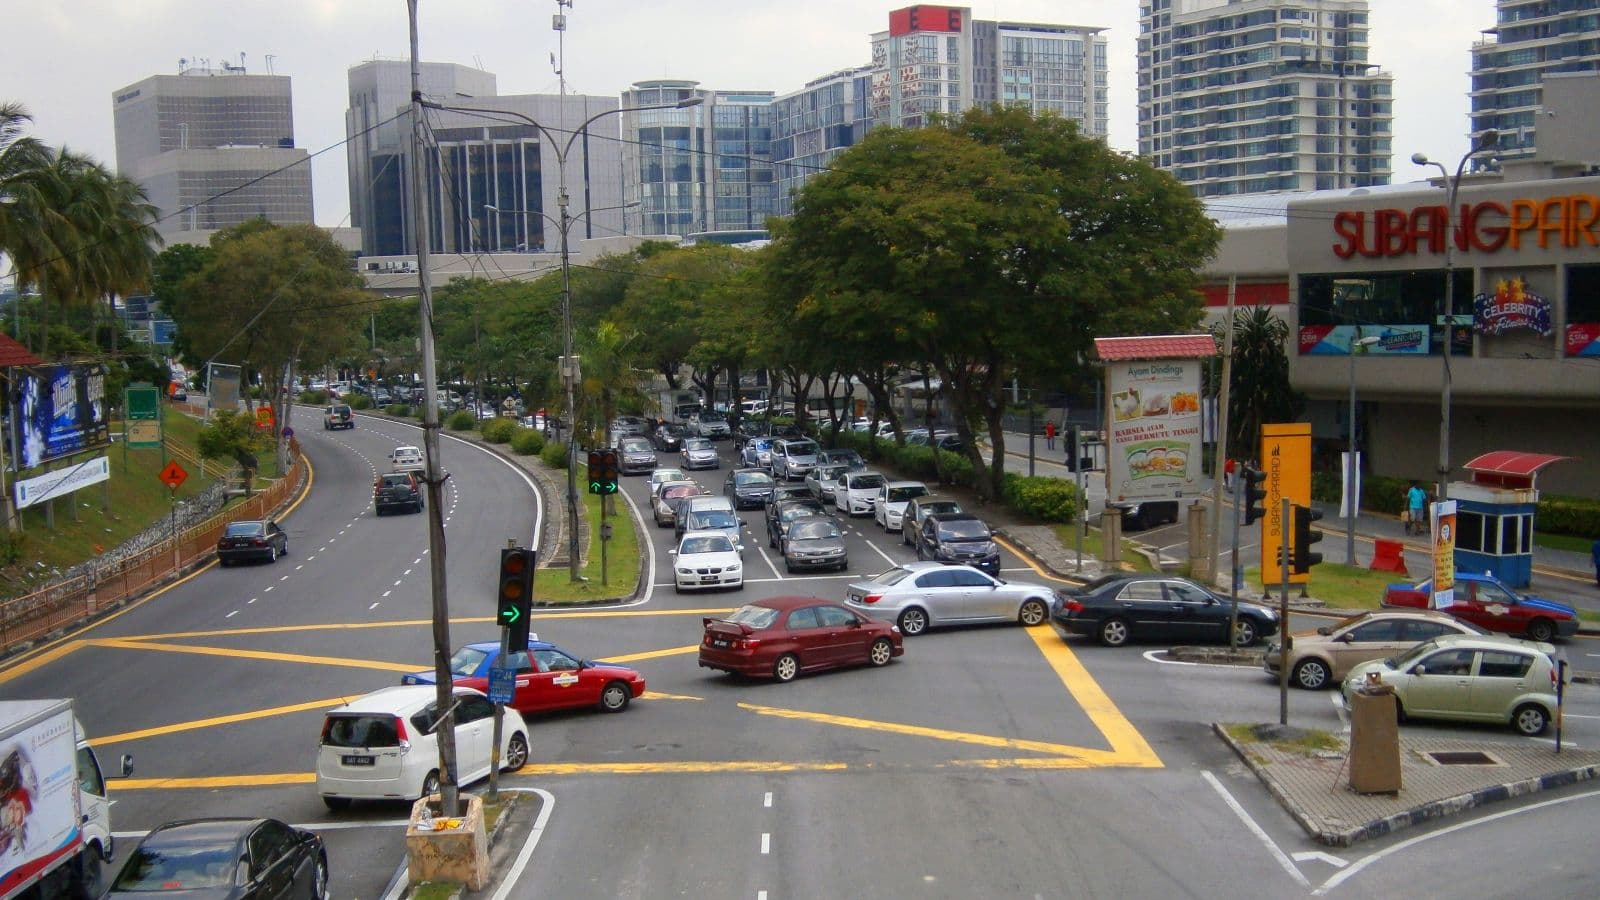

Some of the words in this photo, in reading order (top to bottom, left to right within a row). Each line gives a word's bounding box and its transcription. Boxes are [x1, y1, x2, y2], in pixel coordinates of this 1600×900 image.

[1483, 302, 1541, 319] CELEBRITY
[1128, 368, 1149, 377] Ayam
[1150, 364, 1183, 376] Dindings
